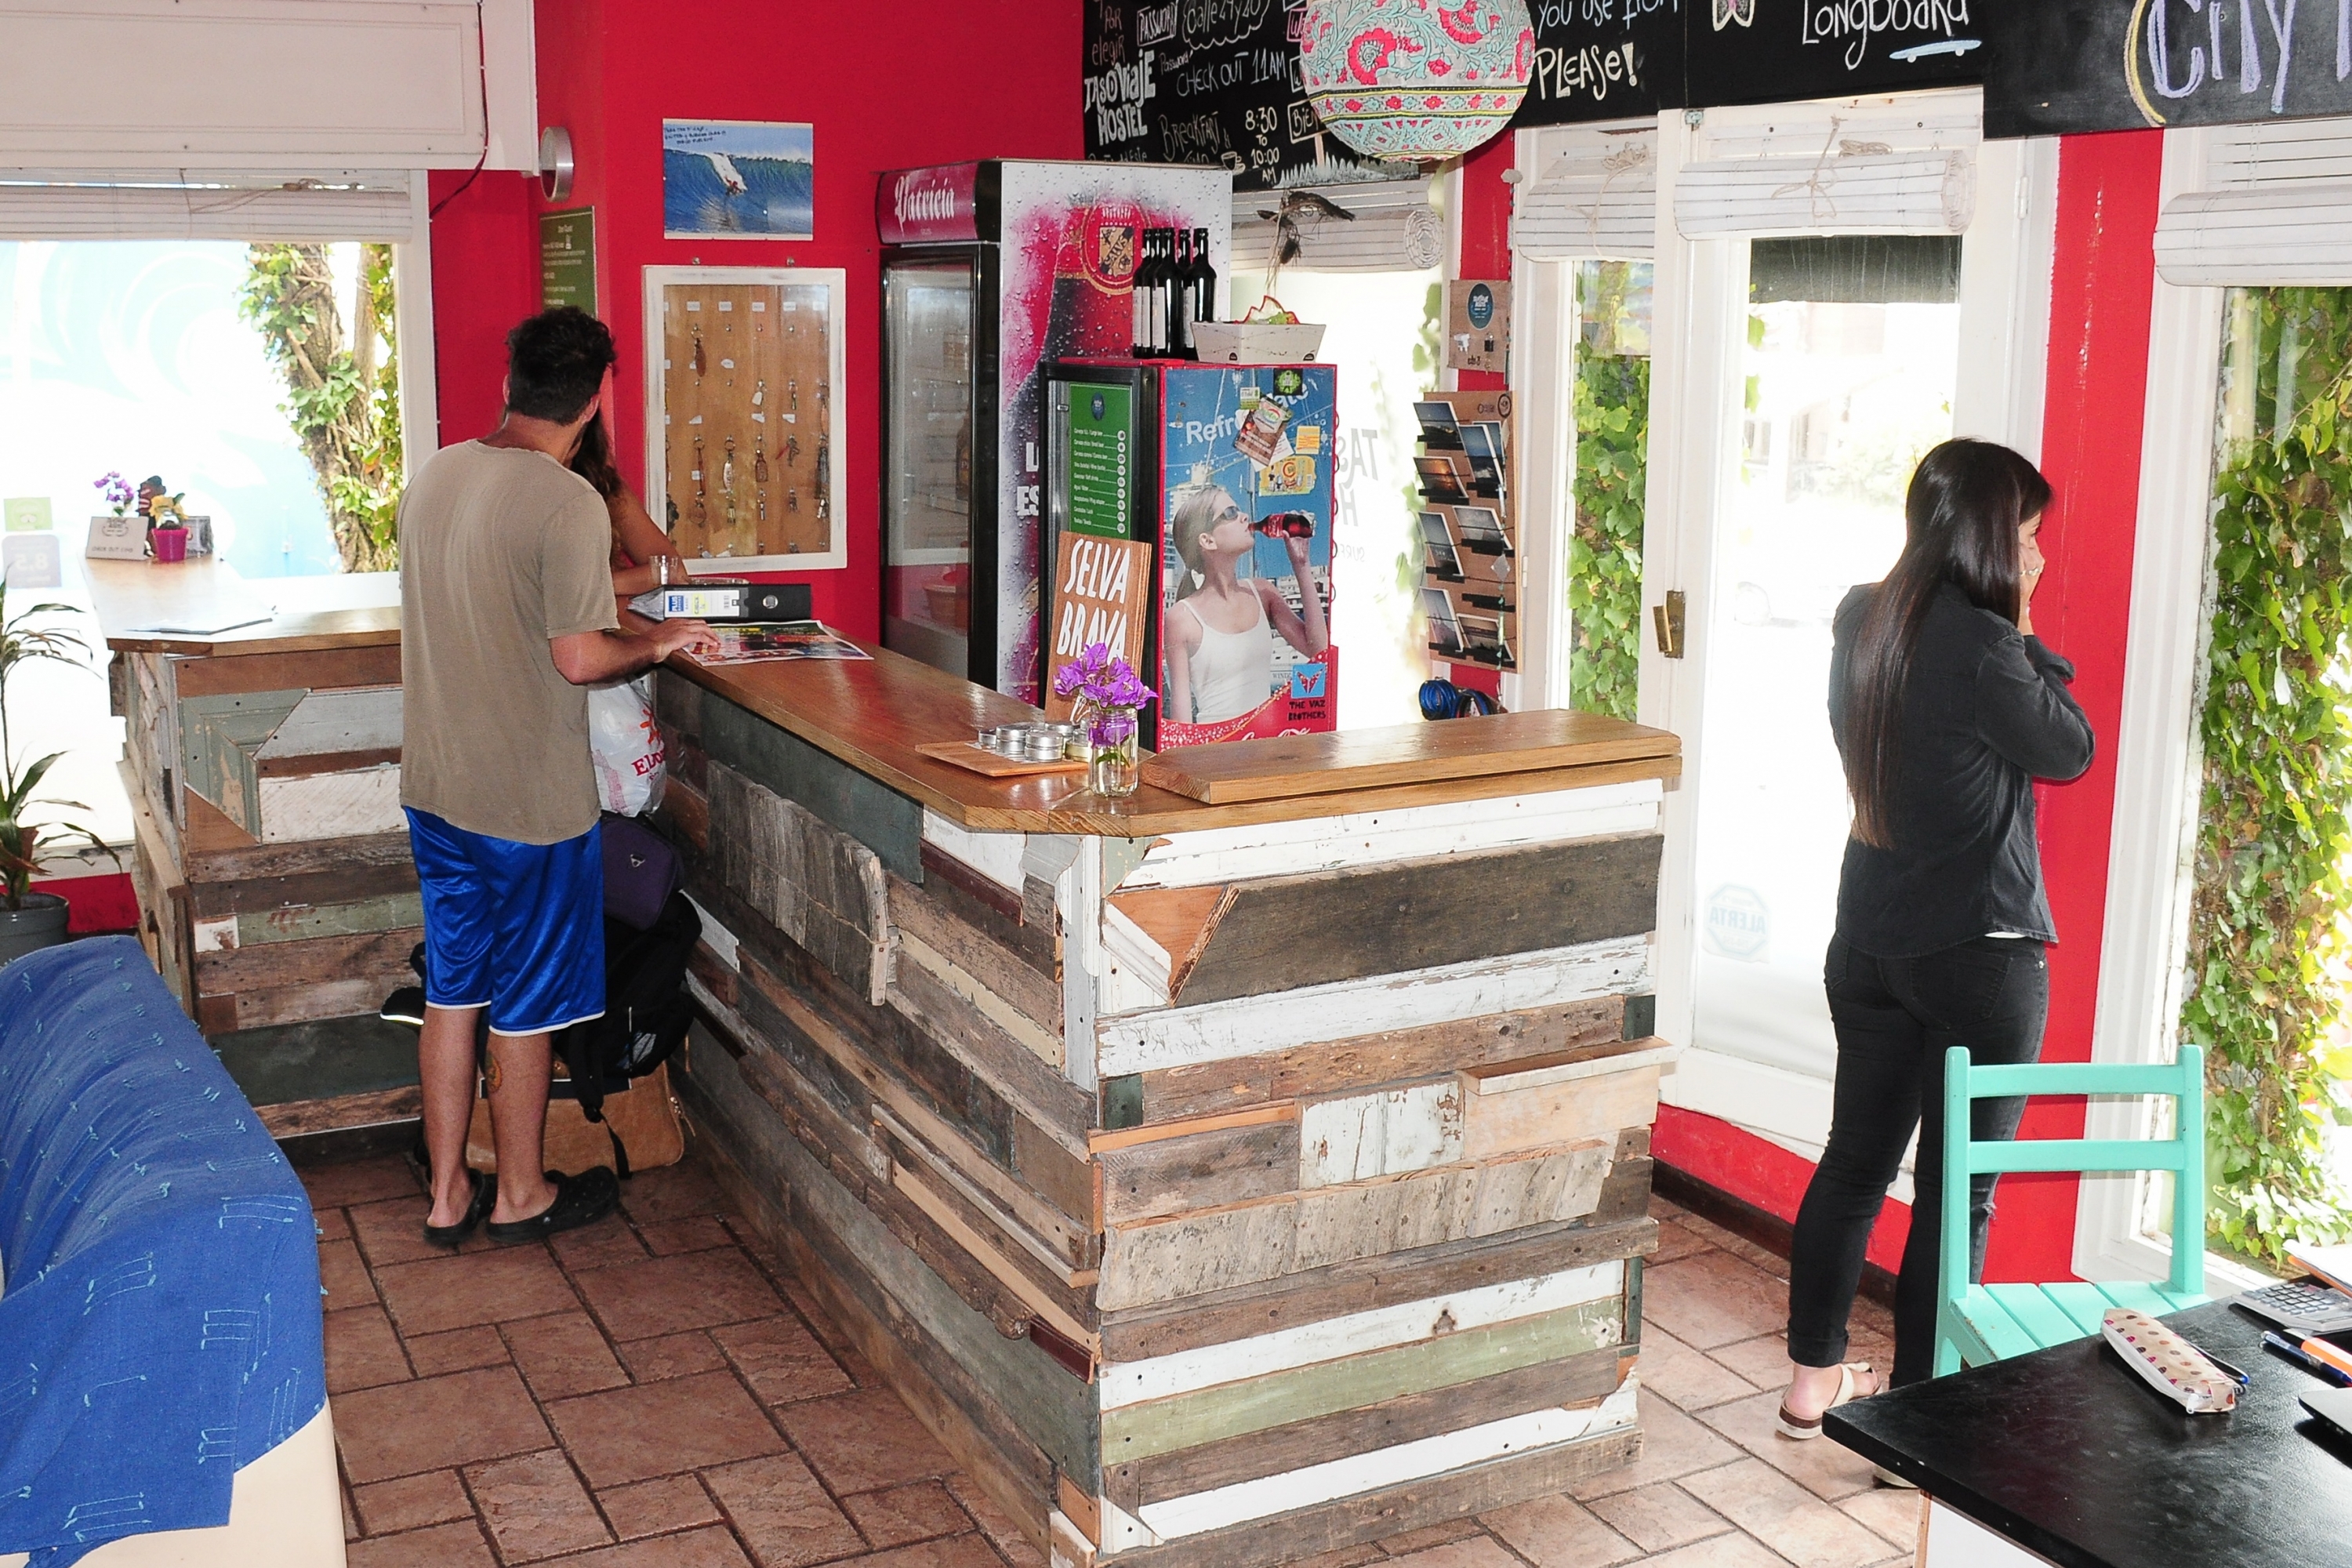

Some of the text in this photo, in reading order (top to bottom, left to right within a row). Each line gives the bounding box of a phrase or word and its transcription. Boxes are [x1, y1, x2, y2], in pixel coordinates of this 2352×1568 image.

[1177, 62, 1219, 97] CHECK
[1220, 52, 1249, 86] OUT
[1098, 103, 1148, 146] HOSTEL
[1245, 107, 1277, 134] 8:30
[1251, 147, 1279, 169] 10:00
[1255, 134, 1268, 147] TO
[1261, 166, 1277, 183] AM
[895, 175, 954, 237] Patricia
[1063, 538, 1130, 604] SELVA
[1056, 601, 1127, 666] BRAVA
[1289, 699, 1326, 710] THE VAZ
